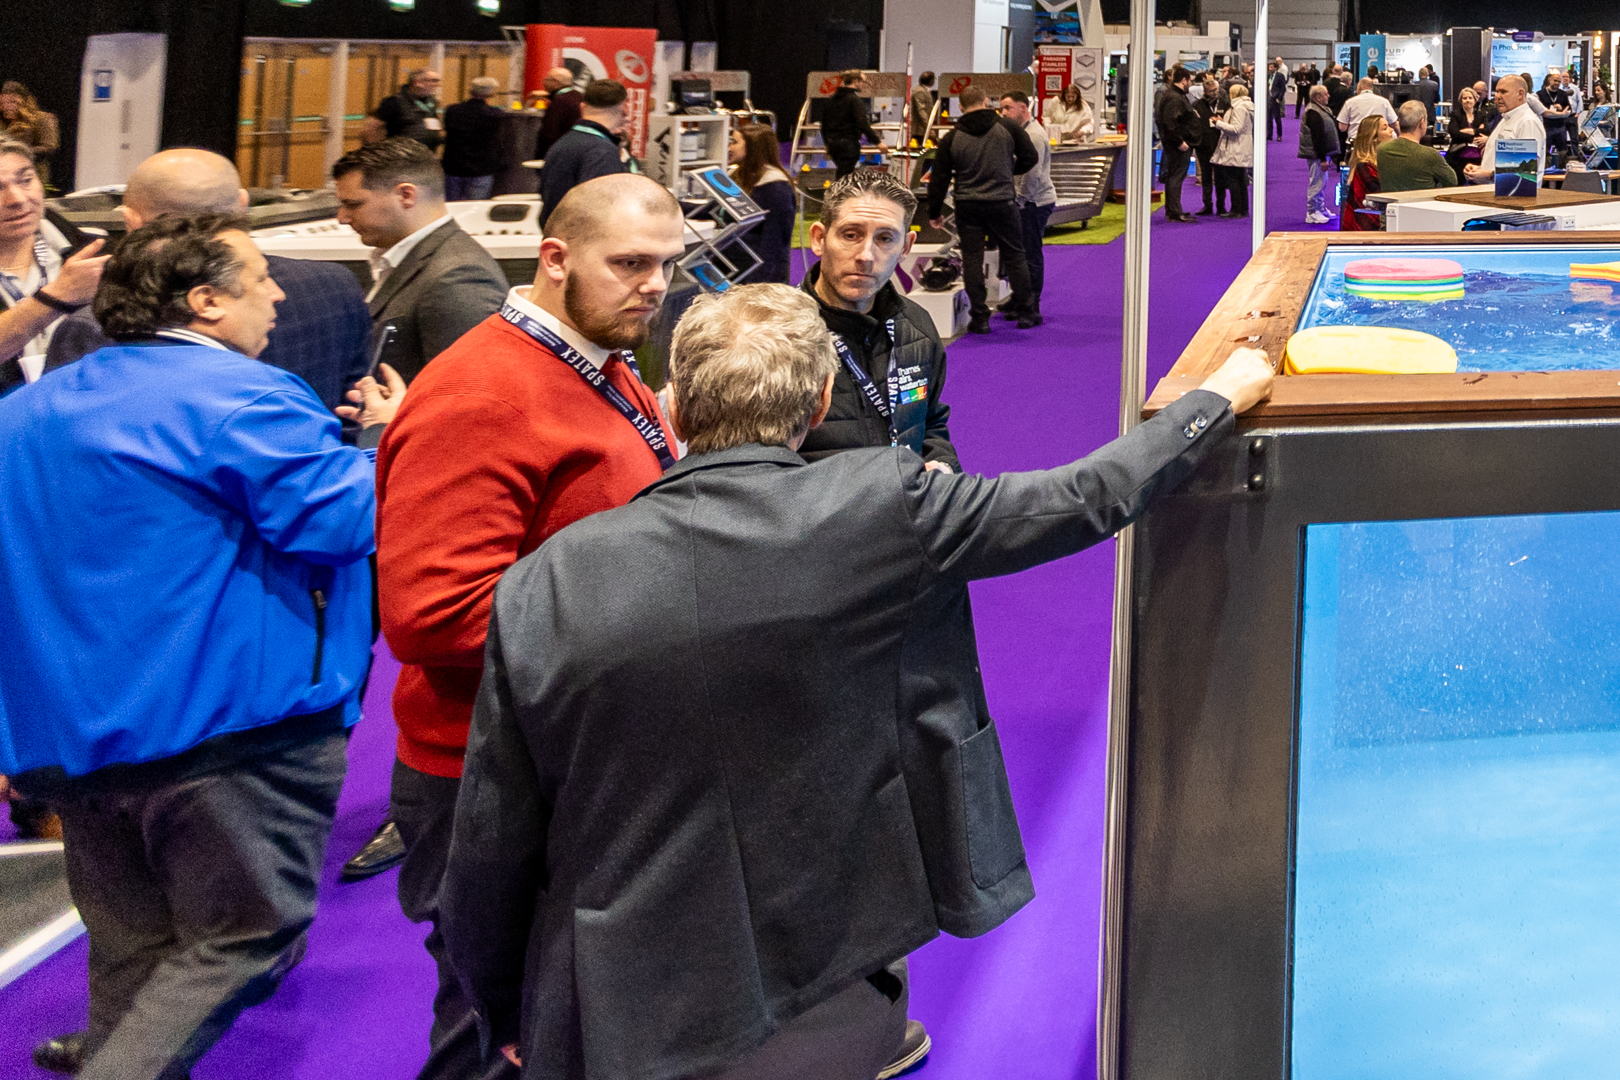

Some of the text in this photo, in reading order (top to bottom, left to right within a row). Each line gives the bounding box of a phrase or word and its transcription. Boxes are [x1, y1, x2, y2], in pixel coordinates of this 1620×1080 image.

[560, 346, 606, 387] SPATEX
[862, 381, 890, 418] SPATEX
[631, 412, 667, 451] SPATEX
